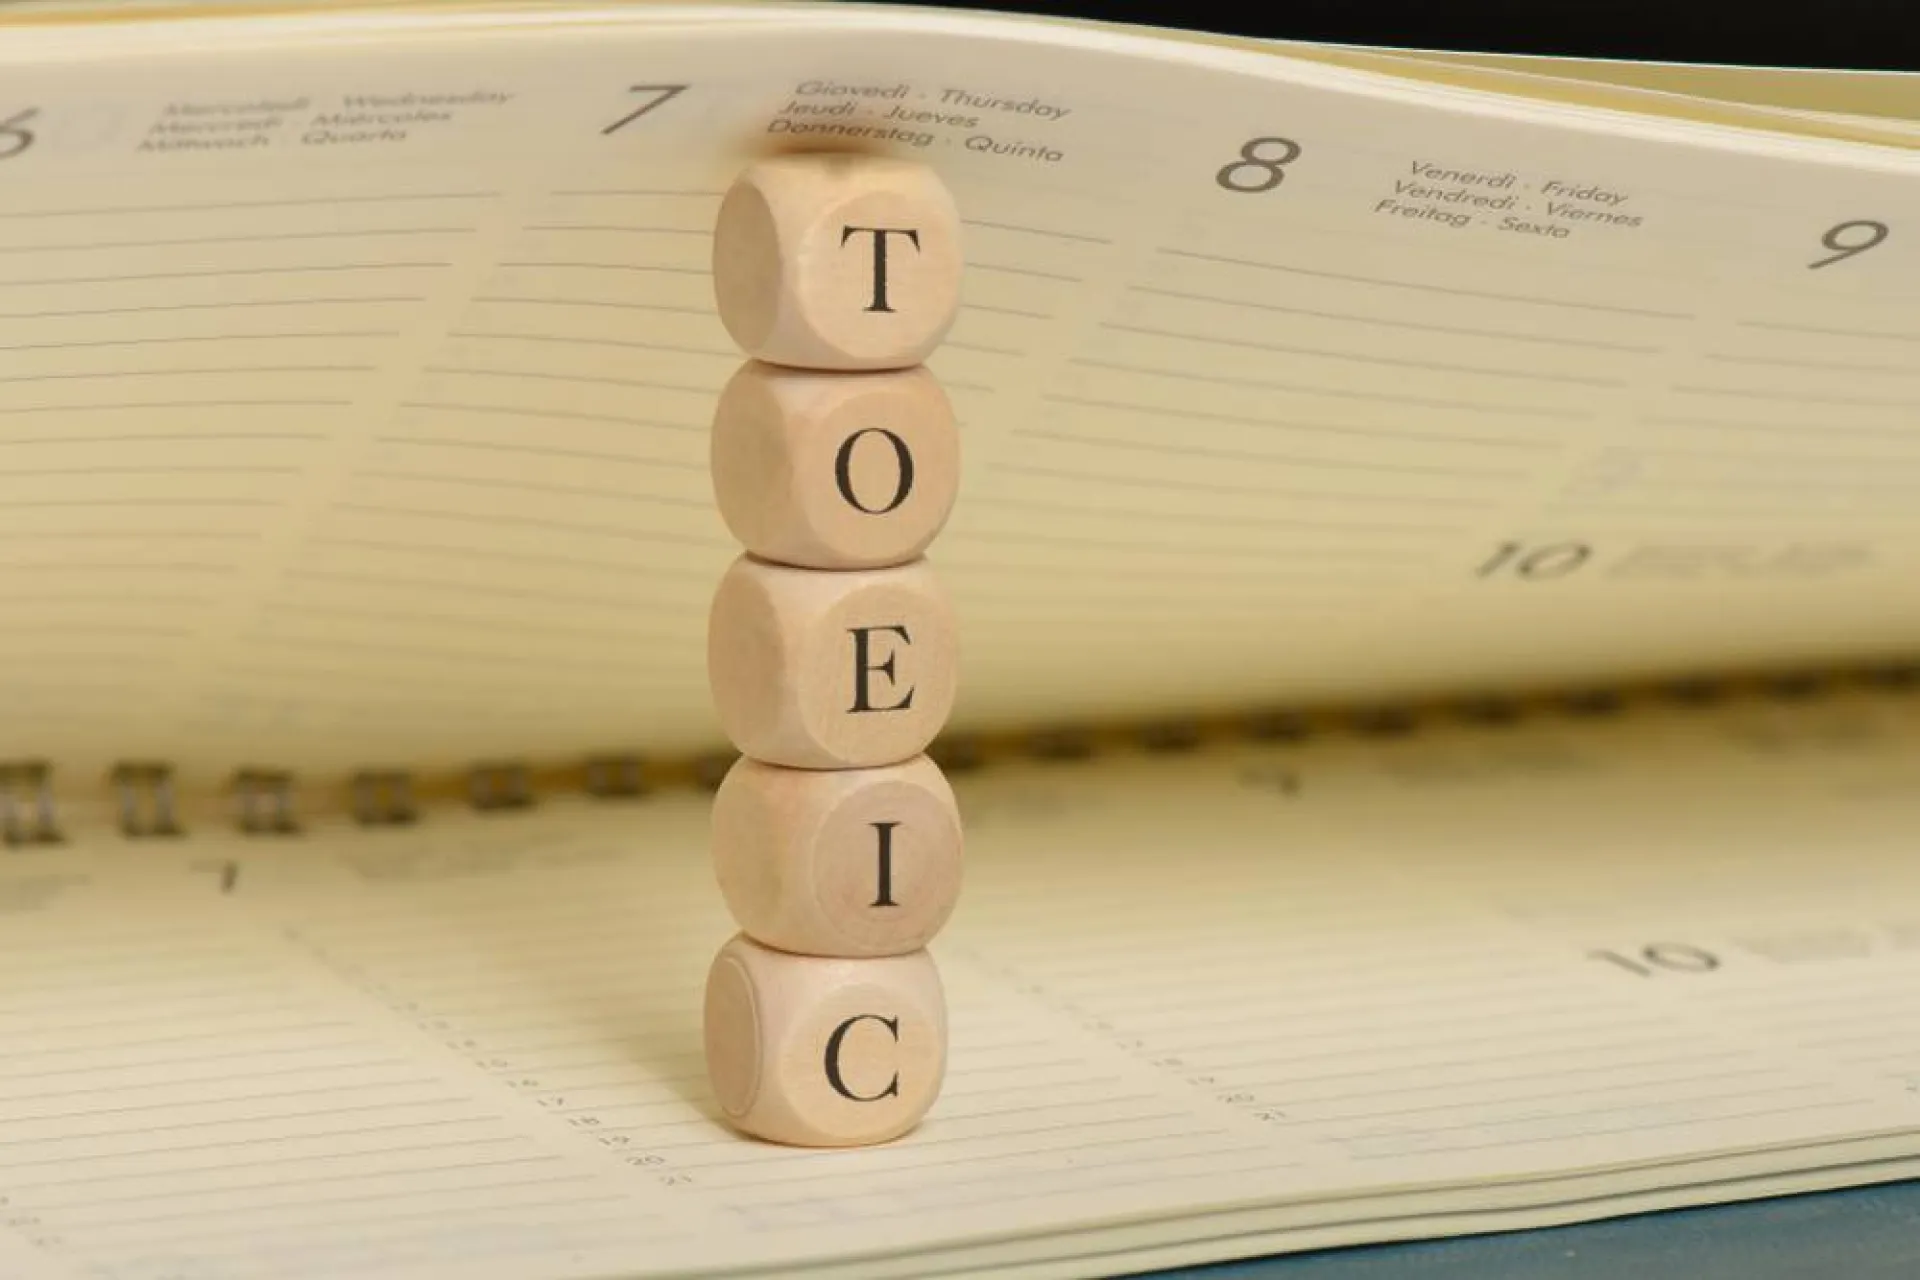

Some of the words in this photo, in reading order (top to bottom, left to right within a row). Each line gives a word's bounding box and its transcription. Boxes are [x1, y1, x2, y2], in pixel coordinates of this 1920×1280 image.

[600, 84, 692, 135] 7
[778, 100, 859, 117] Jeudi
[883, 105, 982, 129] Jueves
[939, 88, 1072, 121] Thursday
[767, 118, 936, 147] Donnerstag
[964, 135, 1065, 162] Quinta
[1215, 137, 1302, 193] 8
[1394, 179, 1520, 211] Vendredi
[1546, 201, 1645, 228] Viernes
[1540, 180, 1629, 207] Friday
[1373, 198, 1472, 228] Freitag
[1497, 216, 1571, 239] Sexta
[1806, 219, 1890, 270] 9
[1473, 539, 1594, 581] 10
[1585, 943, 1721, 979] 10
